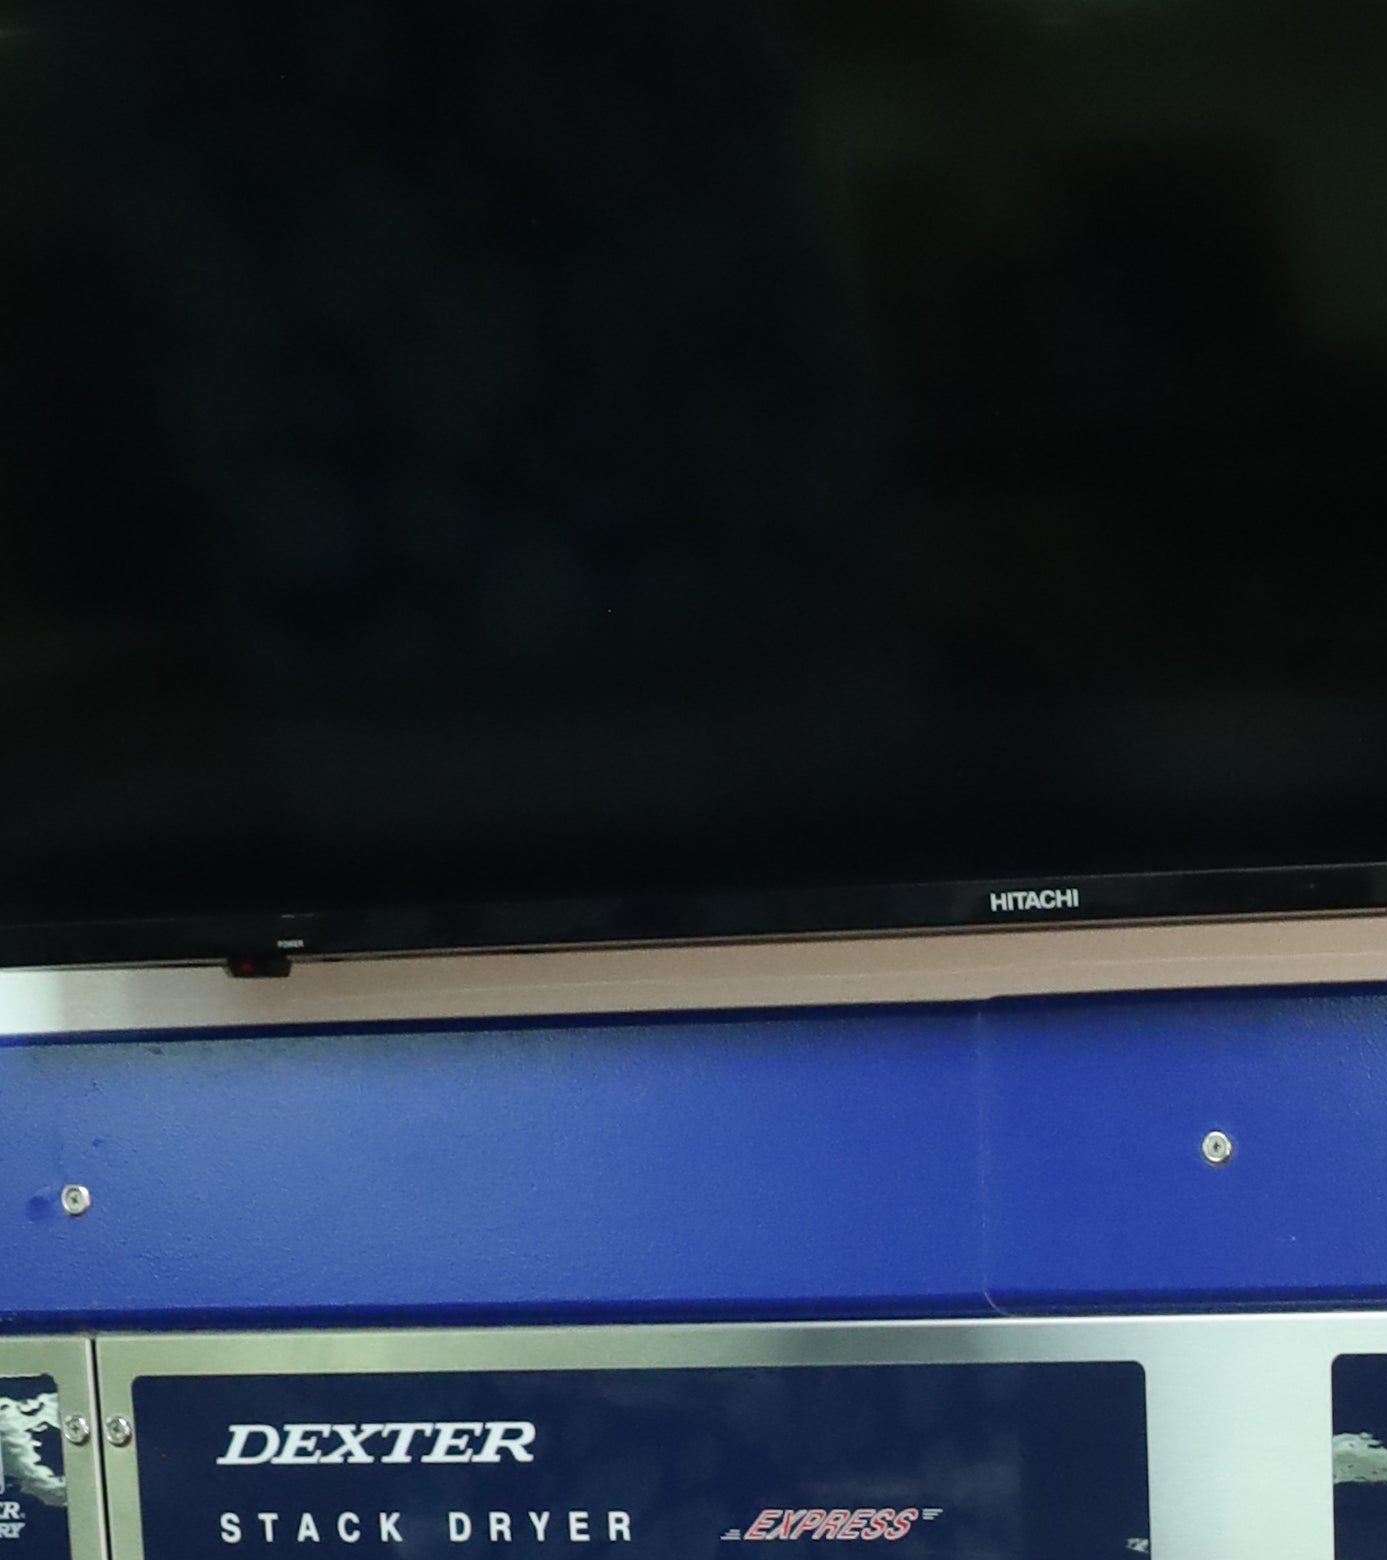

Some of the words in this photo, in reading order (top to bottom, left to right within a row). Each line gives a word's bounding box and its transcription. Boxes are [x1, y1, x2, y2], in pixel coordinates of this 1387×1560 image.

[990, 888, 1080, 912] HITACHI
[216, 1421, 536, 1465] DEXTER
[221, 1512, 402, 1544] STACK
[449, 1511, 632, 1543] DRYER
[744, 1508, 919, 1541] EXPRESS
